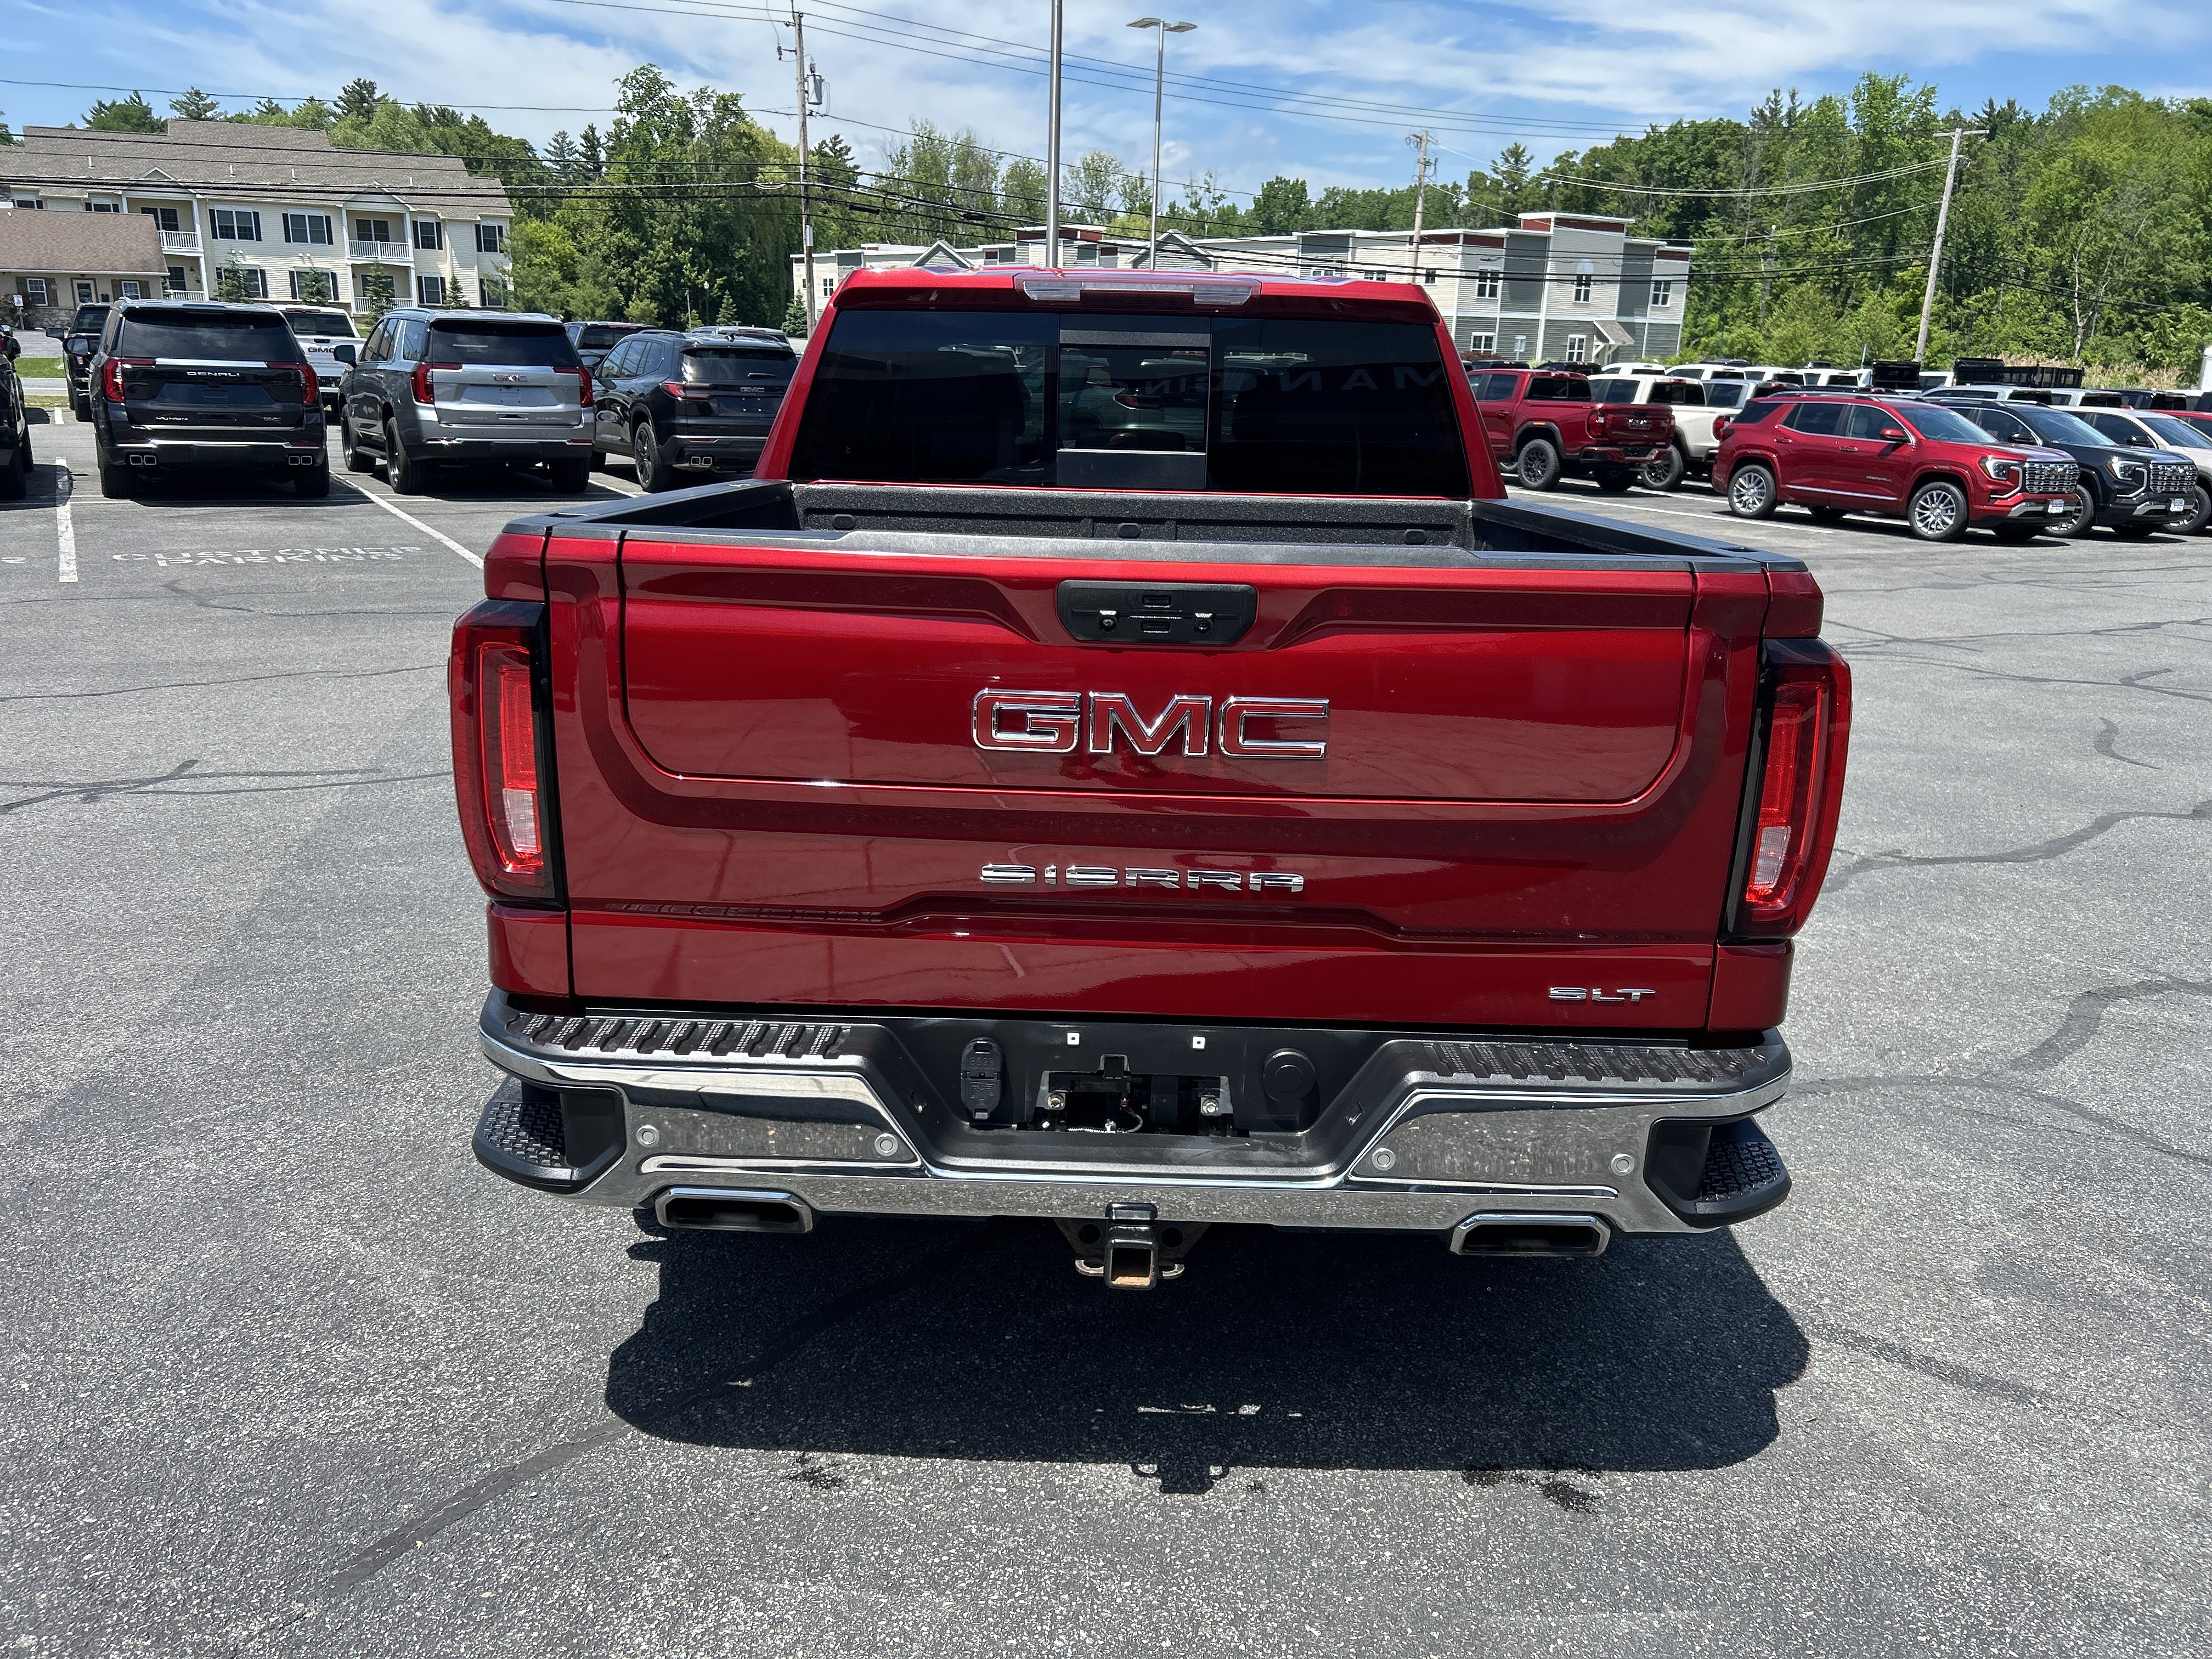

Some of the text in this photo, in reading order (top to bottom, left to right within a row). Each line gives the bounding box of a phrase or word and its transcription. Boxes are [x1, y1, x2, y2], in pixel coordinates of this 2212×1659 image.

[112, 546, 422, 561] CUSTOMER
[157, 554, 402, 567] PARKING
[972, 687, 1330, 759] GMC
[979, 864, 1304, 892] SIERRA
[1549, 987, 1656, 1002] SLT
